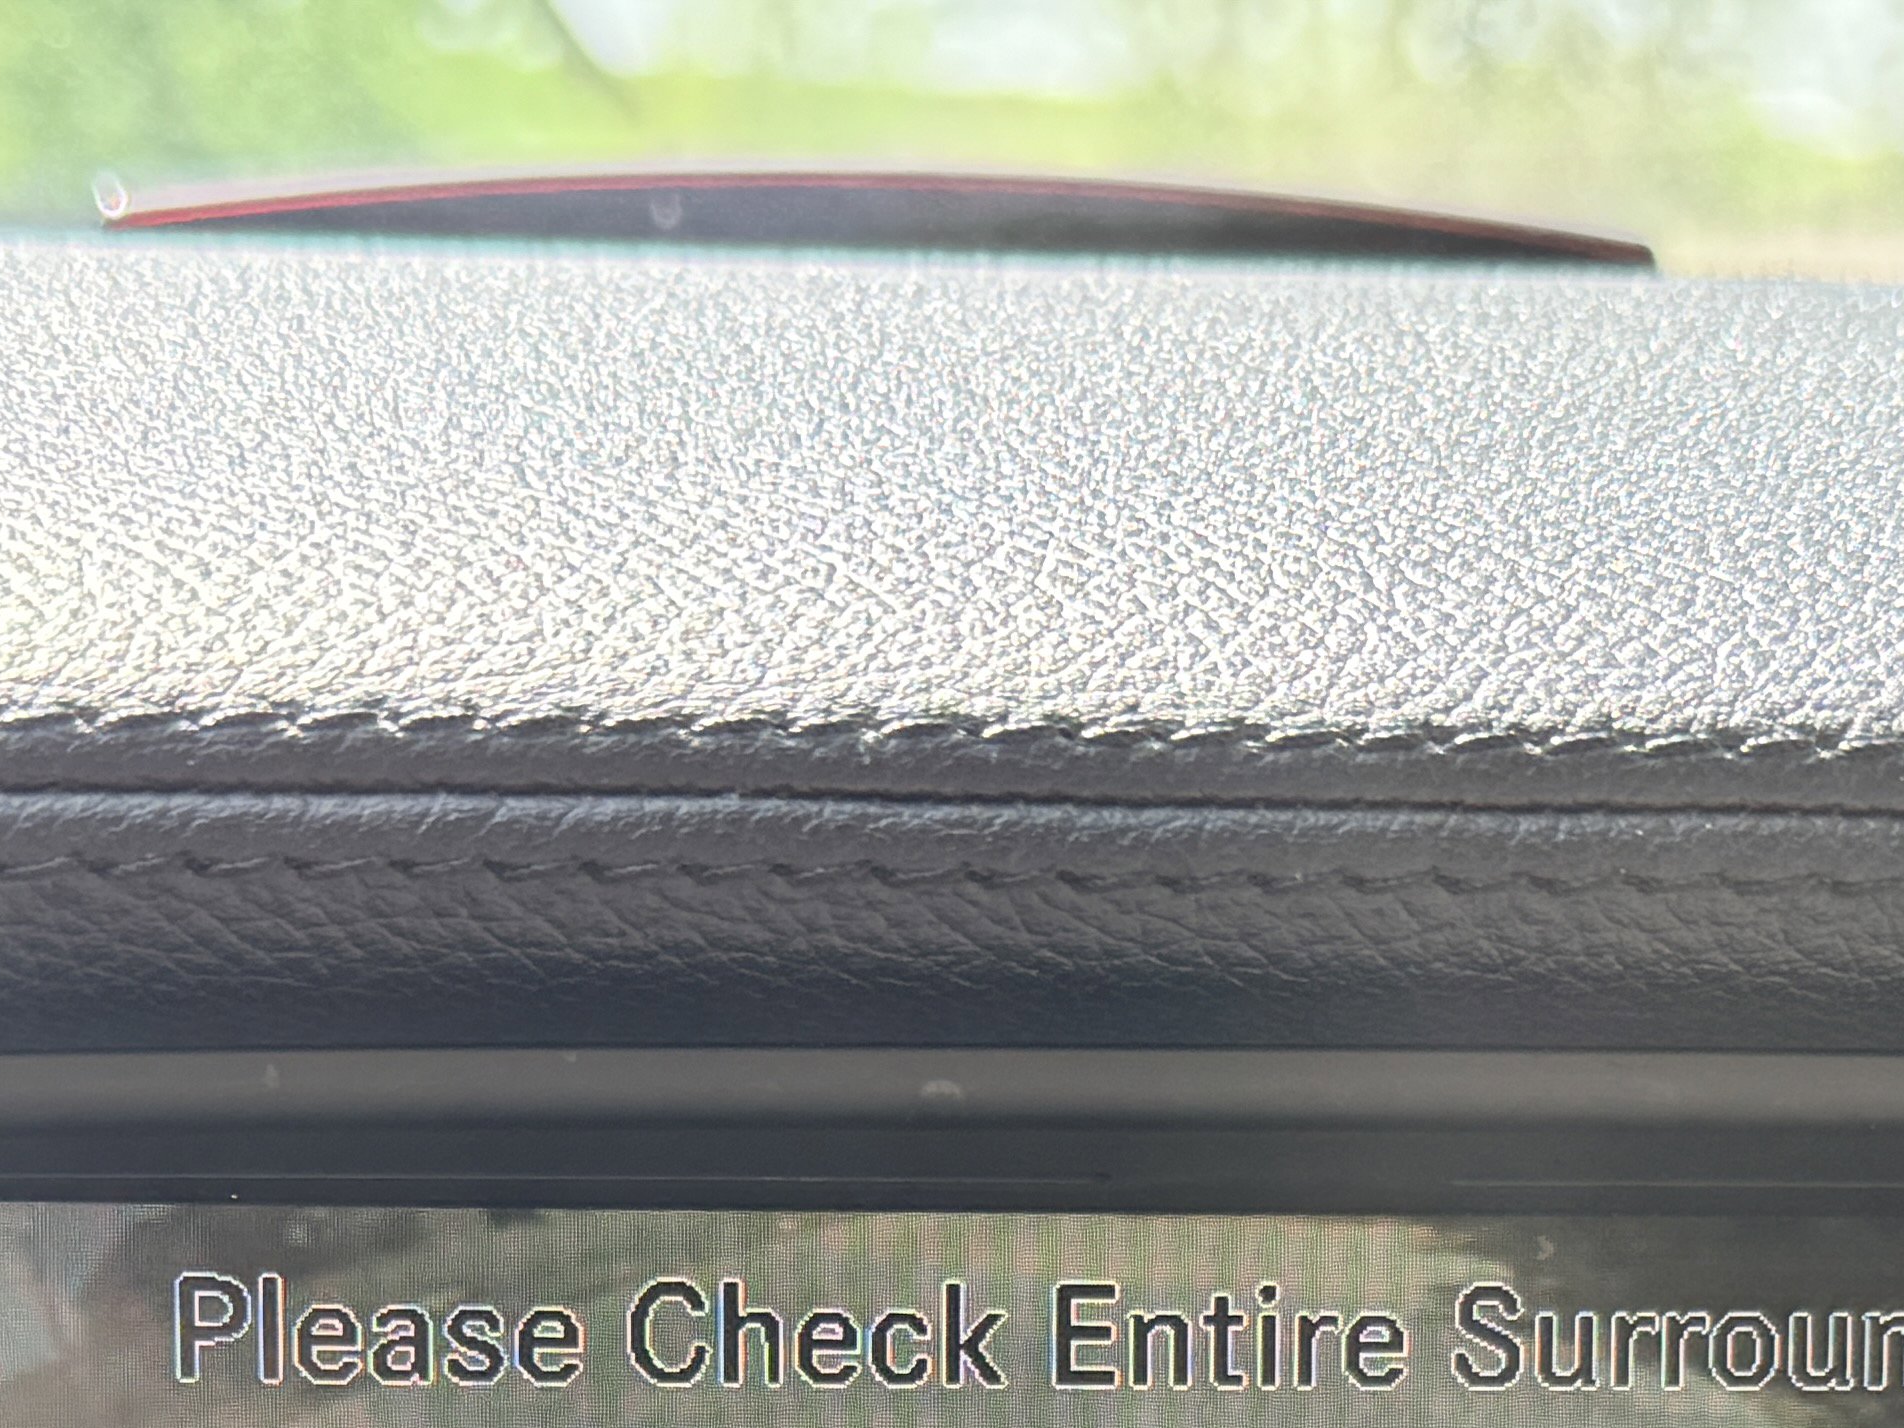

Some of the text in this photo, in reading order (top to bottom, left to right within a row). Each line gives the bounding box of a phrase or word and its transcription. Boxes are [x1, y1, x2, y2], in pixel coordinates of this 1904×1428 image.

[173, 1271, 586, 1388] Please
[627, 1276, 1010, 1390] Check
[1050, 1279, 1412, 1391] Entire
